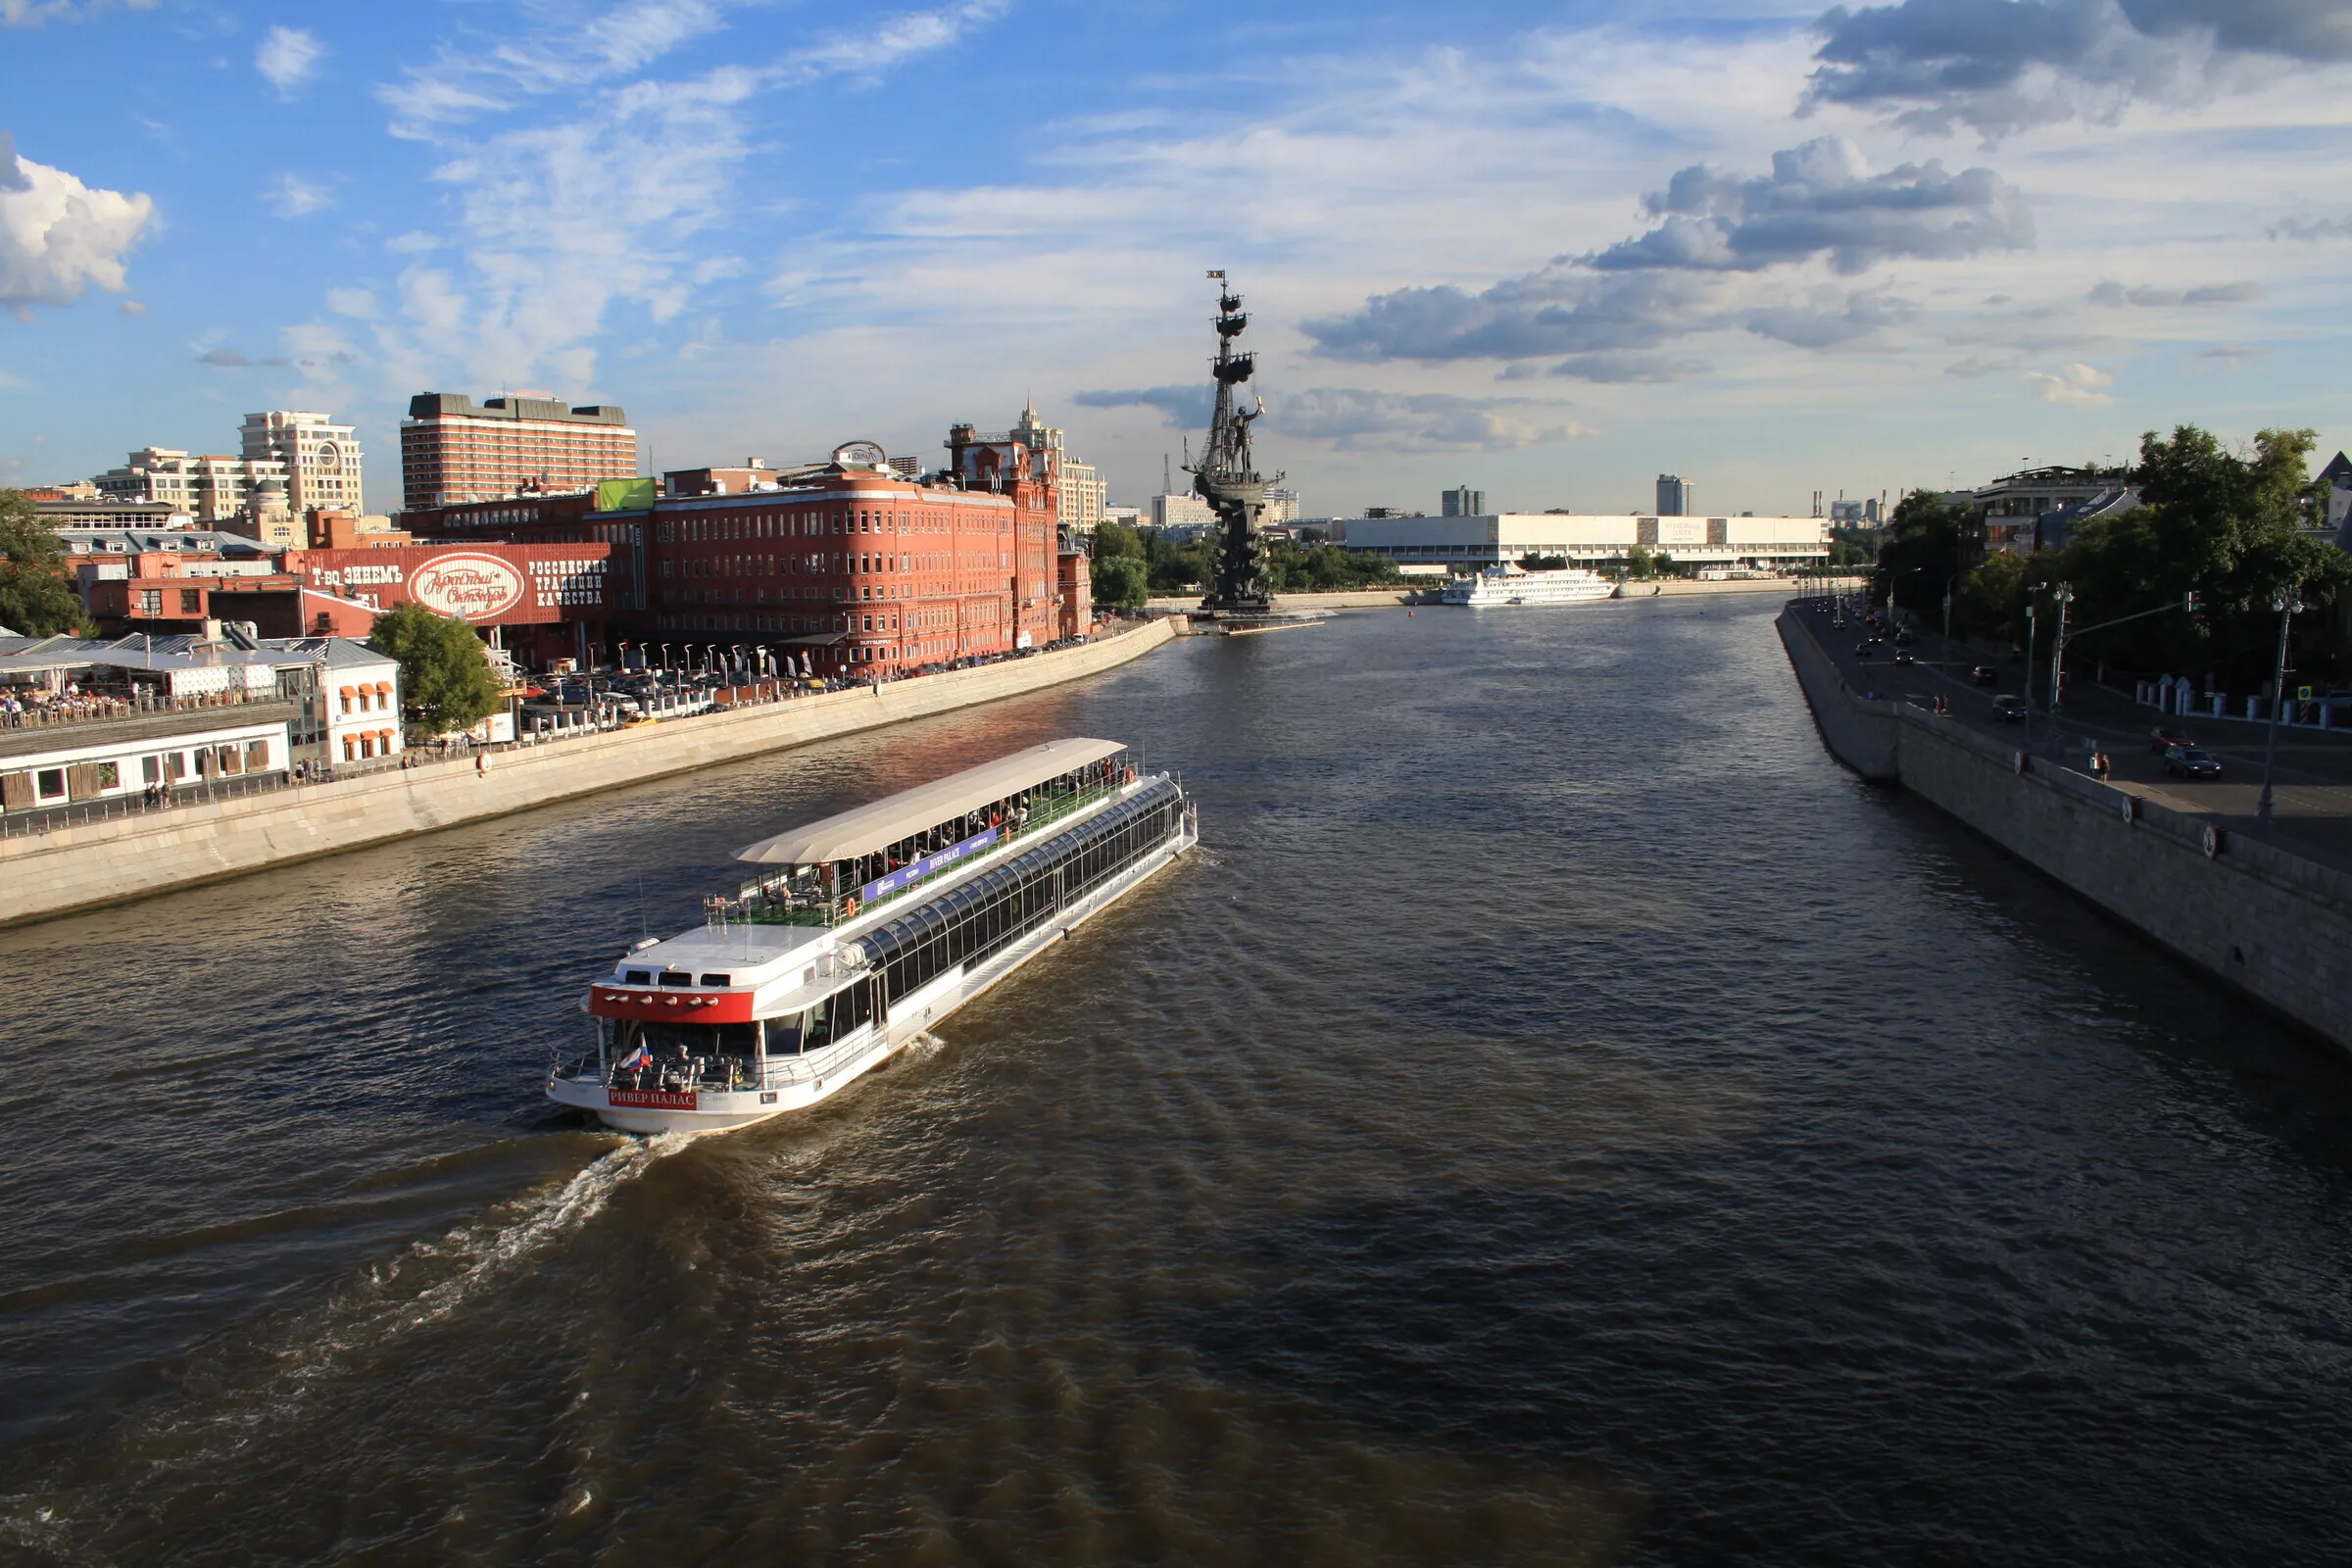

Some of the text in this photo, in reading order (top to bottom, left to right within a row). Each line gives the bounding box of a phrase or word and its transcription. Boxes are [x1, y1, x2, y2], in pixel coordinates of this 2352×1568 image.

[424, 568, 496, 595] Красный
[535, 575, 603, 591] ТРАДИЦИИ
[447, 586, 508, 610] Октябрь
[536, 591, 603, 607] КАЧЕСТВА
[929, 847, 960, 869] RIVER PALACE
[611, 1091, 694, 1105] РИВЕР ПАЛАС
